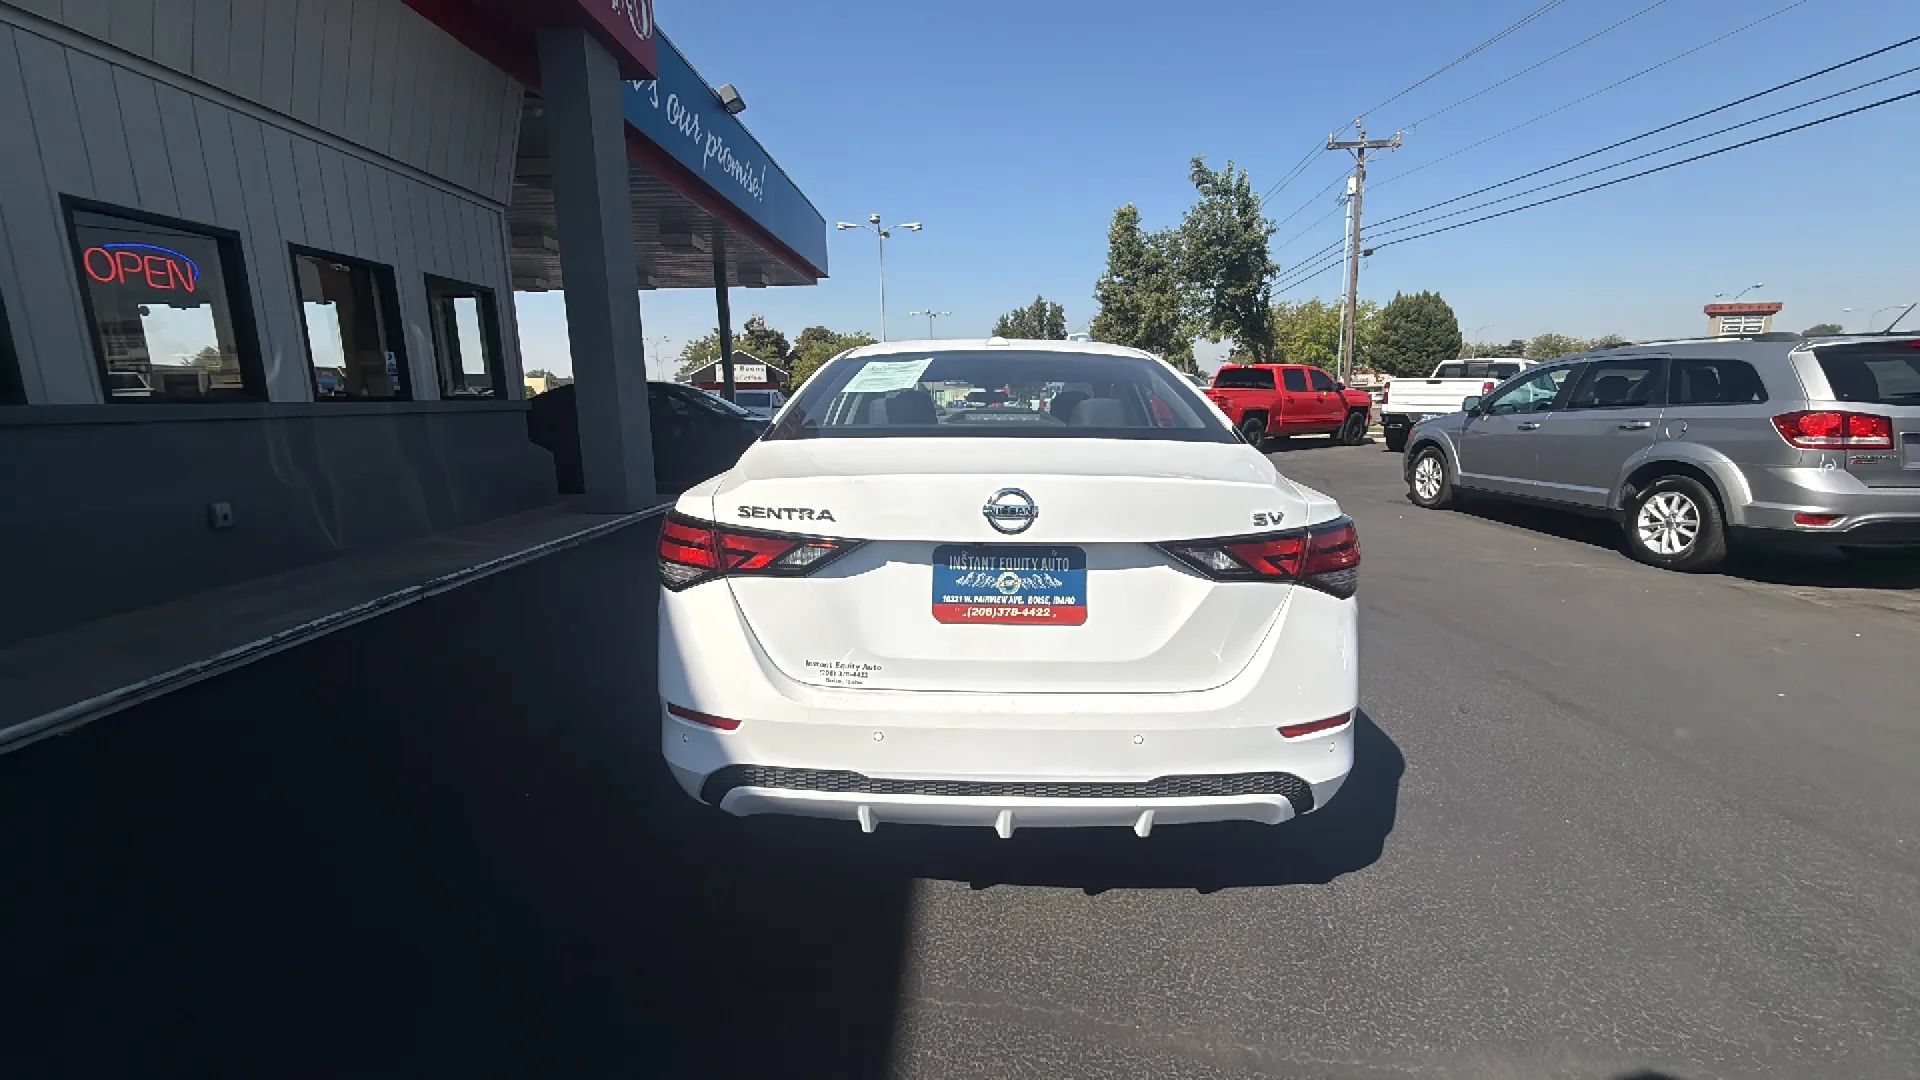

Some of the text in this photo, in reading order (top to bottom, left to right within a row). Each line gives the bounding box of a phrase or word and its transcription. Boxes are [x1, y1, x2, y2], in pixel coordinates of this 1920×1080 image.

[667, 94, 767, 202] our promise!
[83, 247, 195, 293] OPEN
[738, 505, 837, 522] SENTRA
[988, 504, 1033, 516] NISSAN
[1252, 511, 1285, 527] SV
[949, 555, 1070, 572] INSTANT EQUITY AUTO
[1052, 595, 1076, 605] IDAHO
[805, 660, 882, 671] Instant Equity Auto
